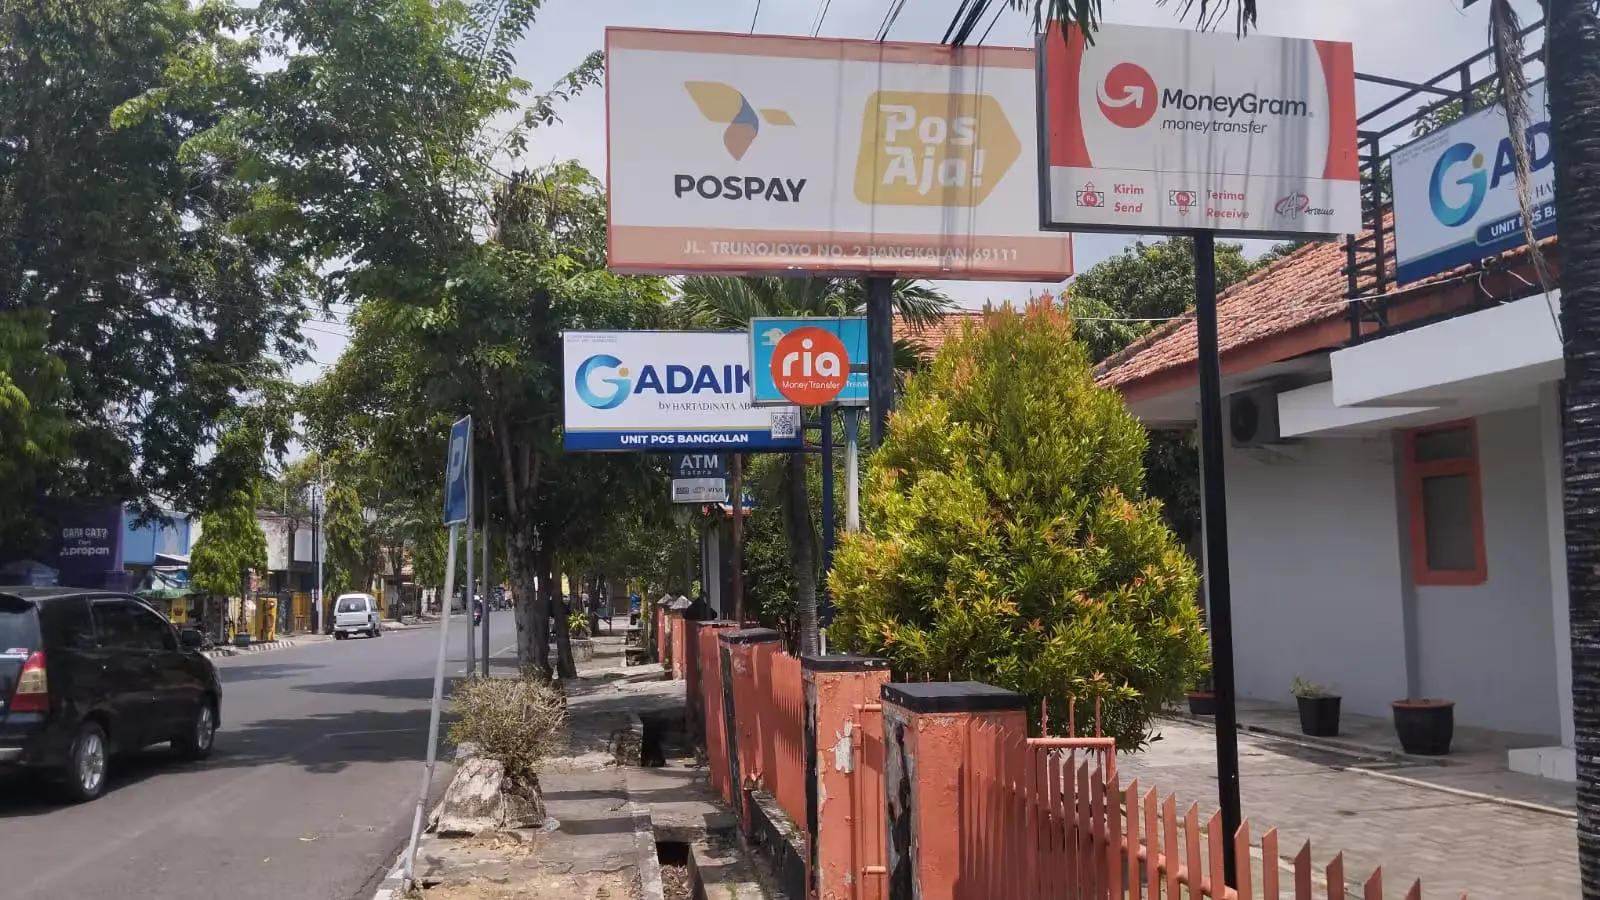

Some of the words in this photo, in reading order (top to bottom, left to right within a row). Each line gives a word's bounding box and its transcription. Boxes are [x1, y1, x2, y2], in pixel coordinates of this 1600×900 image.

[1162, 88, 1307, 118] MoneyGram
[879, 104, 976, 145] Pos
[1162, 119, 1210, 134] money
[1212, 120, 1267, 133] transfer
[881, 146, 985, 195] Aja!
[674, 174, 807, 202] POSPAY
[1114, 184, 1144, 194] Kirim
[1206, 190, 1245, 202] Terima
[1114, 202, 1142, 213] Send
[1207, 208, 1249, 219] Receive
[1491, 219, 1516, 237] UNIT
[684, 240, 705, 254] JL.
[711, 241, 811, 257] TRUNOJOYO
[818, 244, 847, 258] NO.
[854, 246, 862, 258] 2
[867, 246, 966, 261] BANGKALAN
[973, 248, 1017, 261] 69111
[783, 338, 840, 377] ria
[782, 381, 808, 391] Money
[809, 381, 840, 389] Transfer
[658, 401, 671, 413] by
[672, 402, 736, 411] HARTADINATA
[620, 435, 648, 444] UNIT
[651, 434, 675, 444] POS
[677, 433, 749, 443] BANGKALAN
[680, 454, 718, 469] ATM
